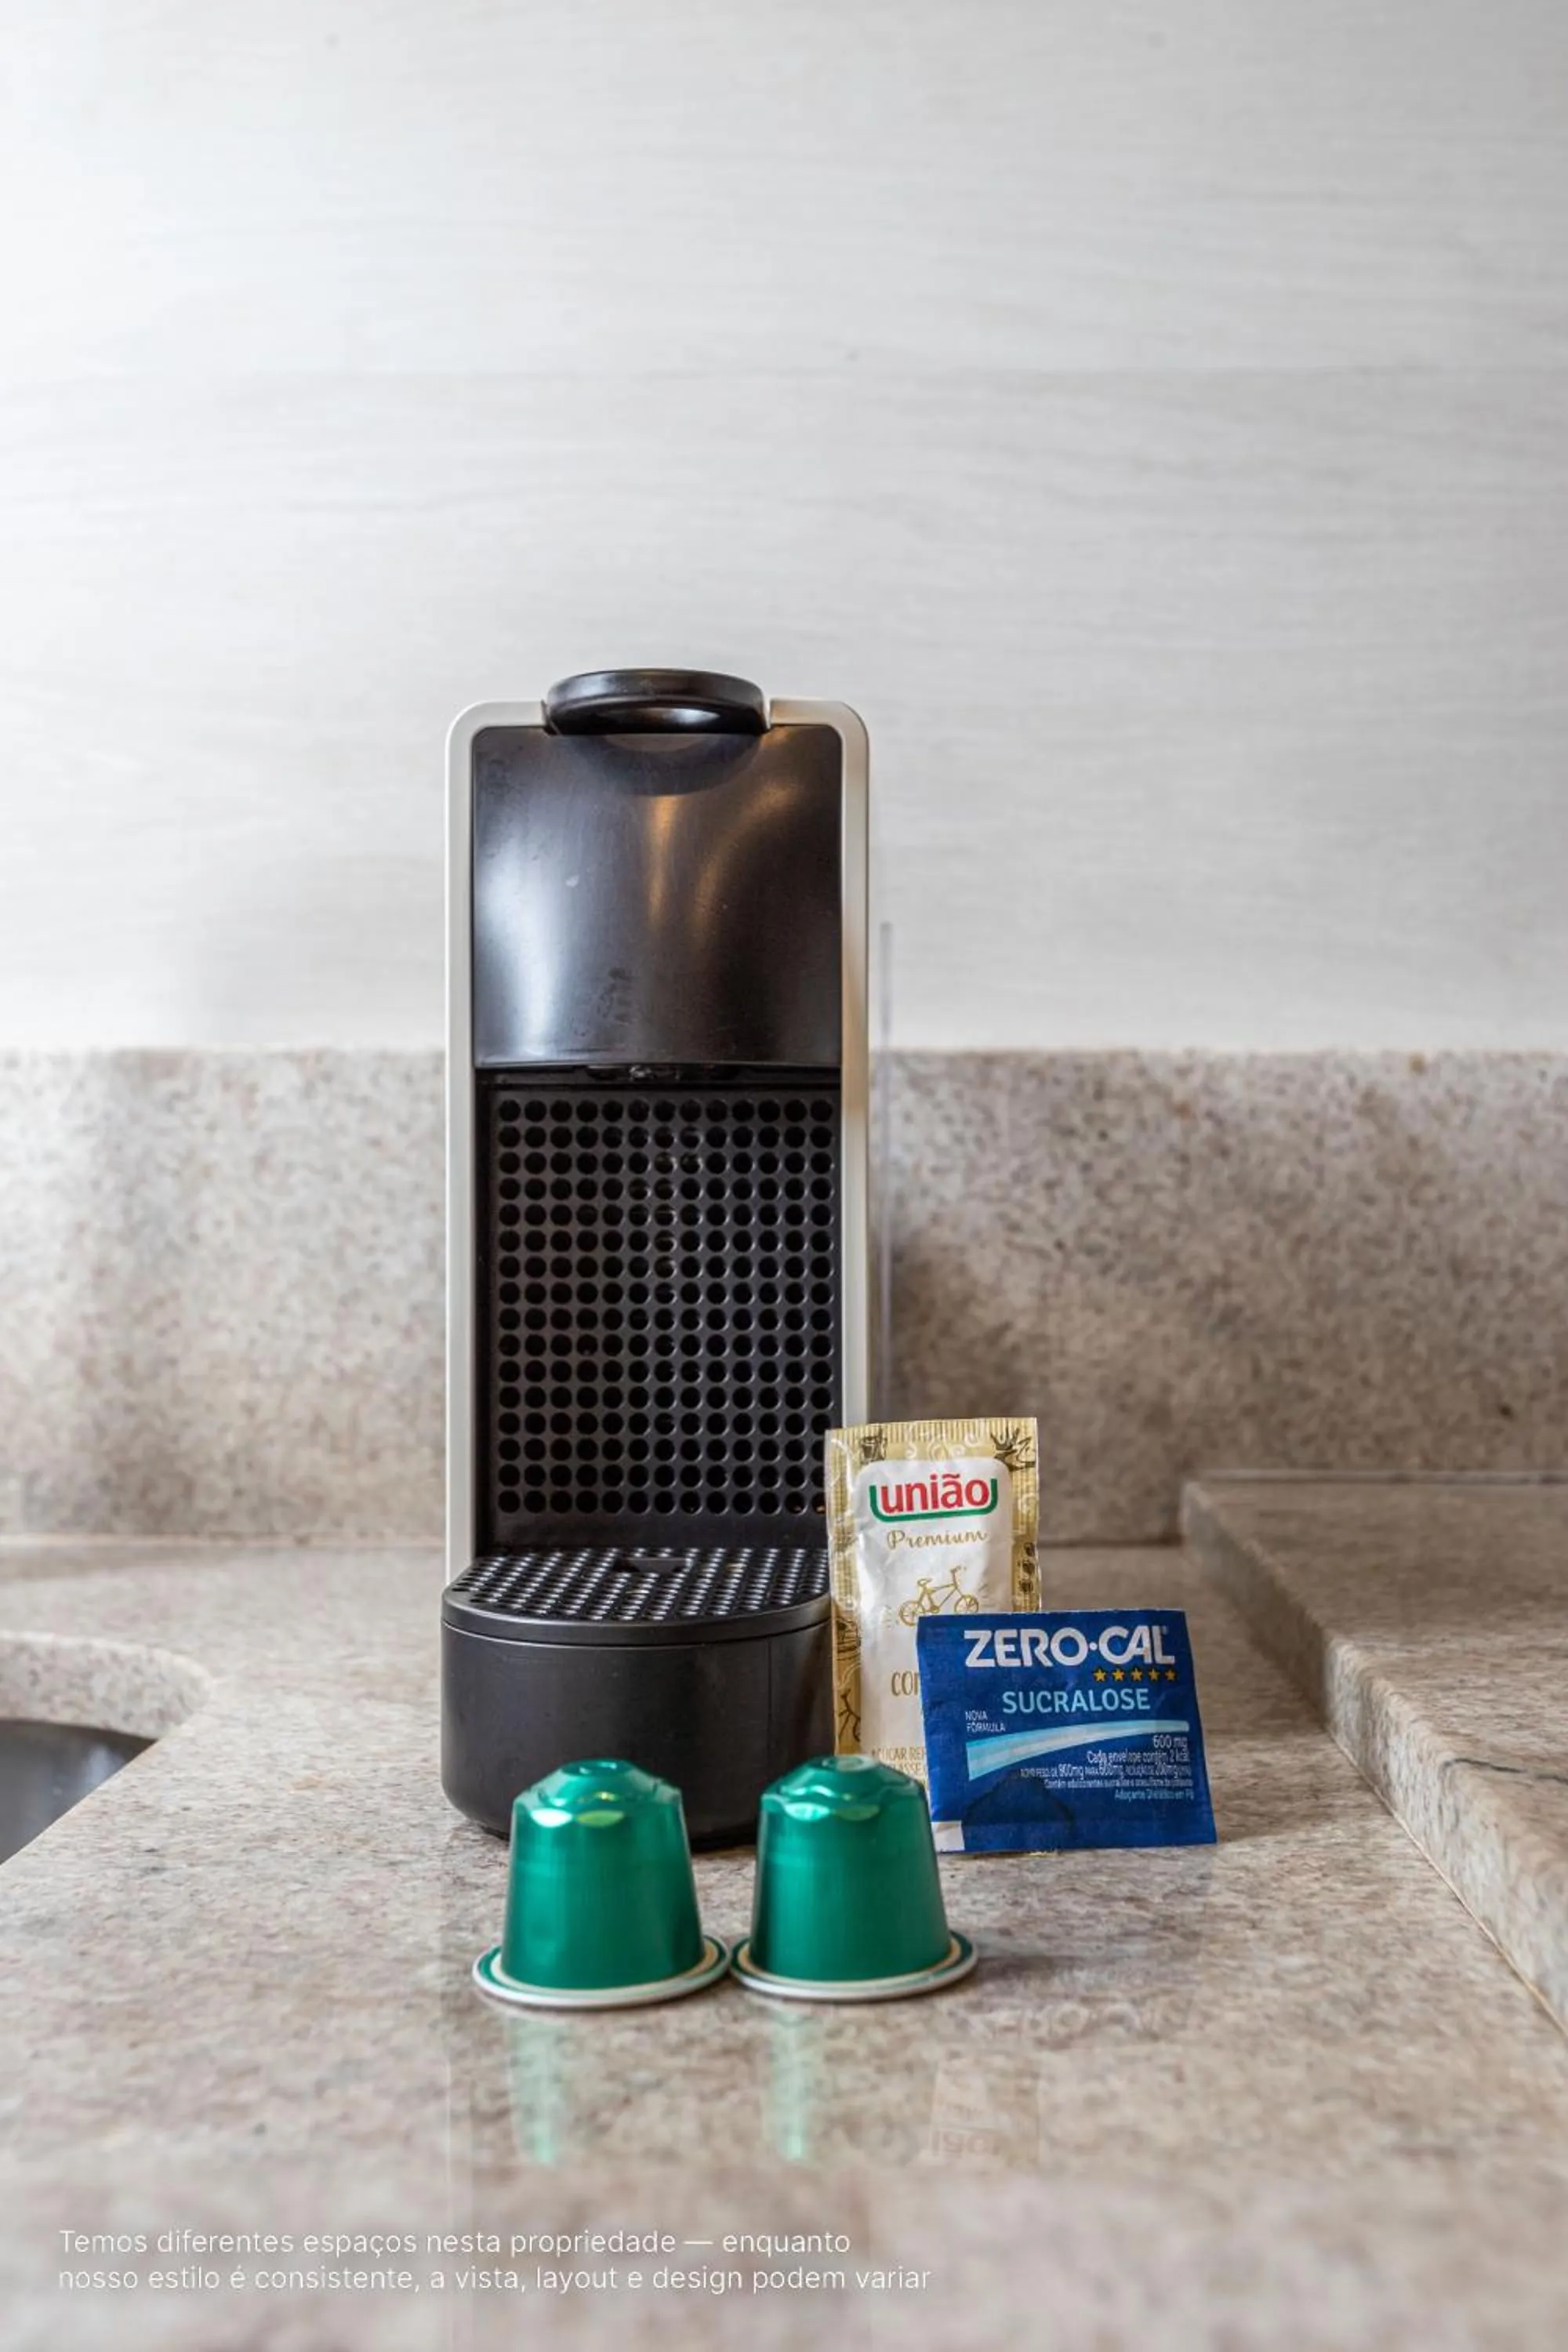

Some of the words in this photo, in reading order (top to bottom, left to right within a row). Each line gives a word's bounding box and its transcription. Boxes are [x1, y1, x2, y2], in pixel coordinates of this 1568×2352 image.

[880, 1473, 989, 1513] união
[887, 1529, 988, 1550] Premium
[1002, 1688, 1151, 1714] SUCRALOSE
[965, 1710, 988, 1722] NOVA
[1152, 1734, 1171, 1748] 600
